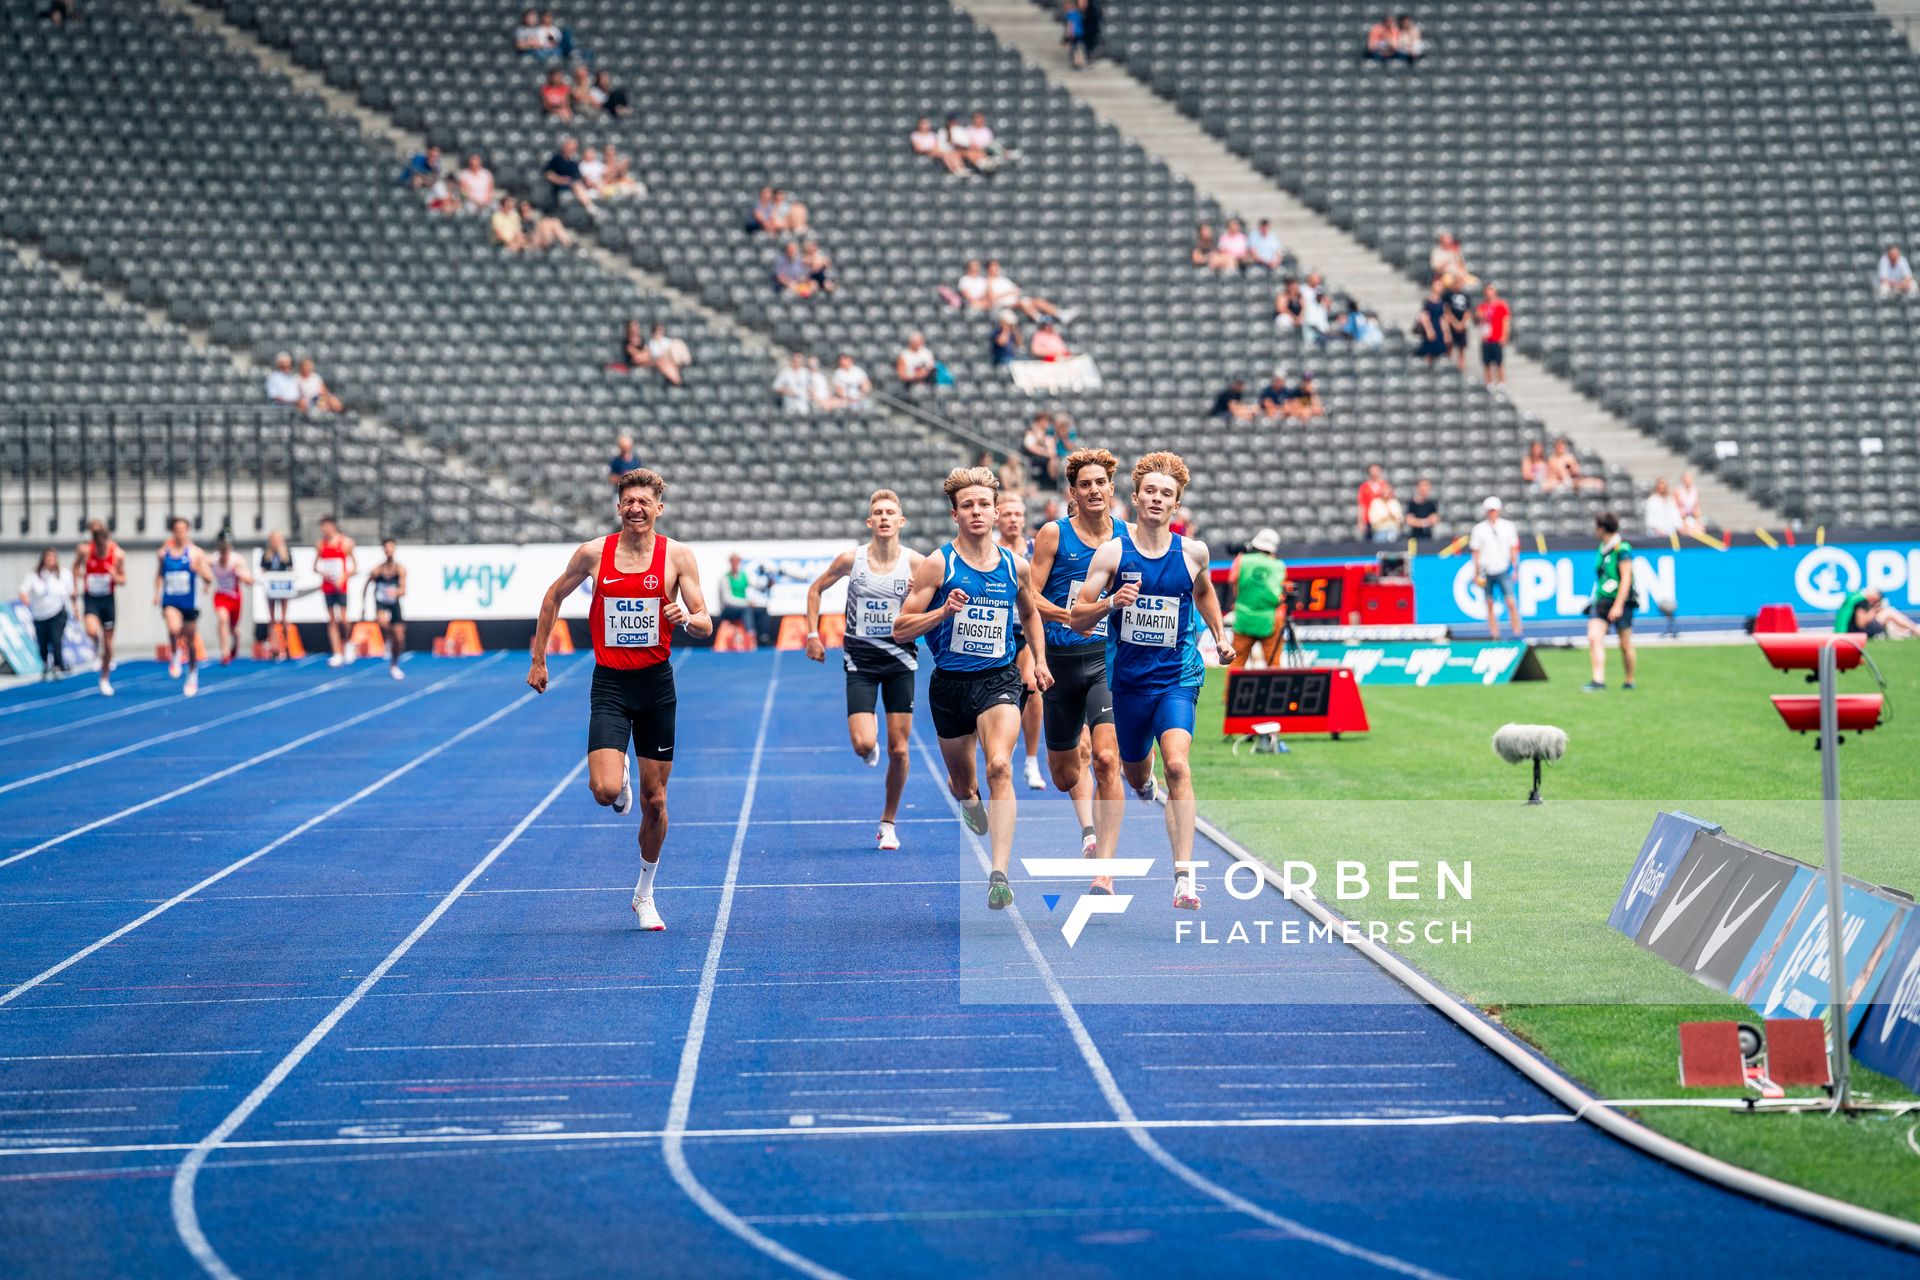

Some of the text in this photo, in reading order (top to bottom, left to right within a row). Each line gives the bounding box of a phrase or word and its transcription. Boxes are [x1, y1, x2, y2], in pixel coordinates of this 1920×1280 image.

[443, 564, 516, 607] wgv
[1518, 555, 1676, 617] PLN
[972, 596, 1009, 607] Villingen
[609, 615, 655, 629] T. KLOSE
[1124, 611, 1134, 625] R.
[1136, 613, 1176, 630] MARTIN
[957, 622, 1003, 639] ENGSTLER
[1145, 633, 1164, 641] PLAN
[976, 643, 994, 651] PLAN
